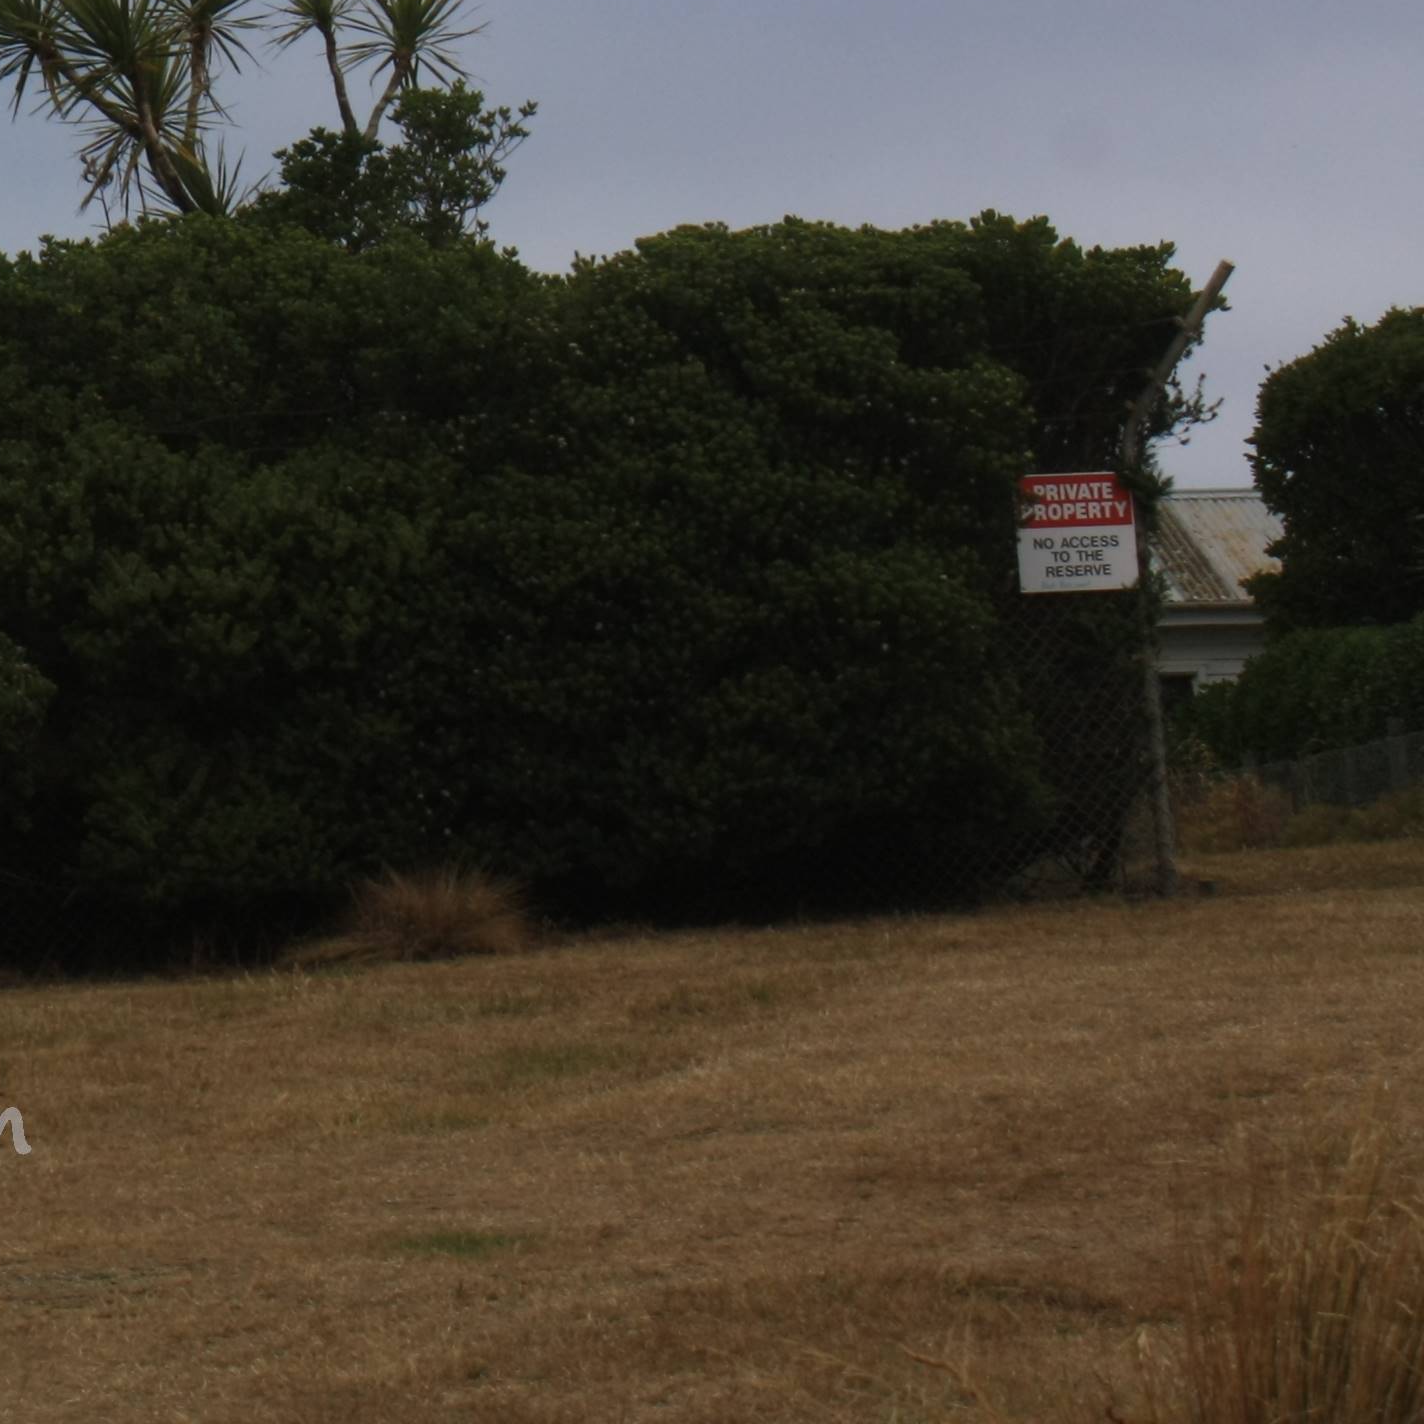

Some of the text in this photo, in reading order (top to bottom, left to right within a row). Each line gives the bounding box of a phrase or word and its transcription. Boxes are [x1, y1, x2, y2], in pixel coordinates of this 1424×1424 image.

[1033, 482, 1113, 501] PRIVATE
[1021, 501, 1127, 521] PROPERTY
[1033, 535, 1119, 550] NO ACCESS
[1052, 550, 1104, 563] TO THE
[1046, 564, 1112, 577] RESERVE
